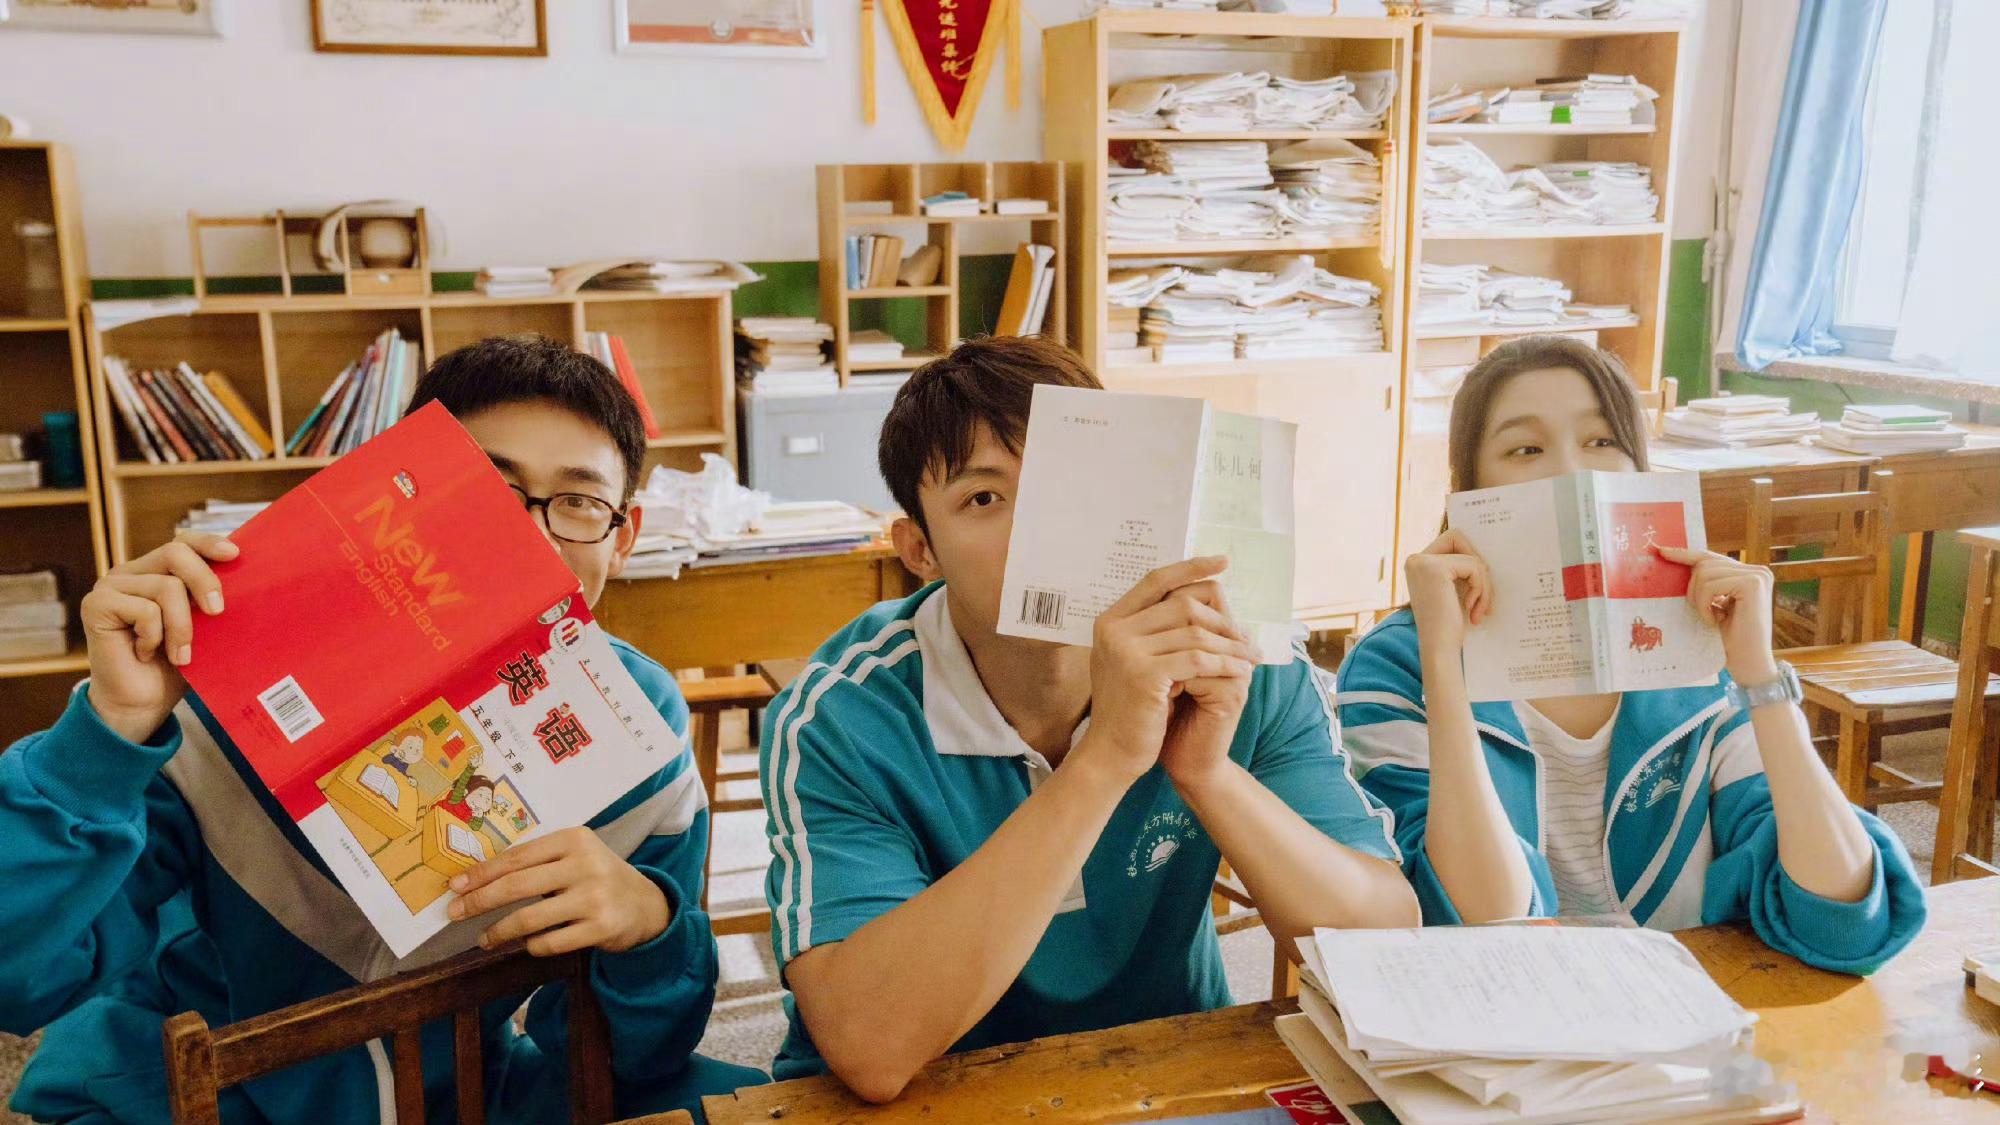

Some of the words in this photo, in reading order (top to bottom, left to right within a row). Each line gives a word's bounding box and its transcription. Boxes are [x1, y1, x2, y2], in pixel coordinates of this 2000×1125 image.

[339, 541, 400, 617] English
[354, 494, 464, 606] New
[374, 553, 452, 651] Standard
[471, 705, 502, 743] 五年级
[504, 751, 525, 775] 下册
[497, 650, 593, 764] 英语
